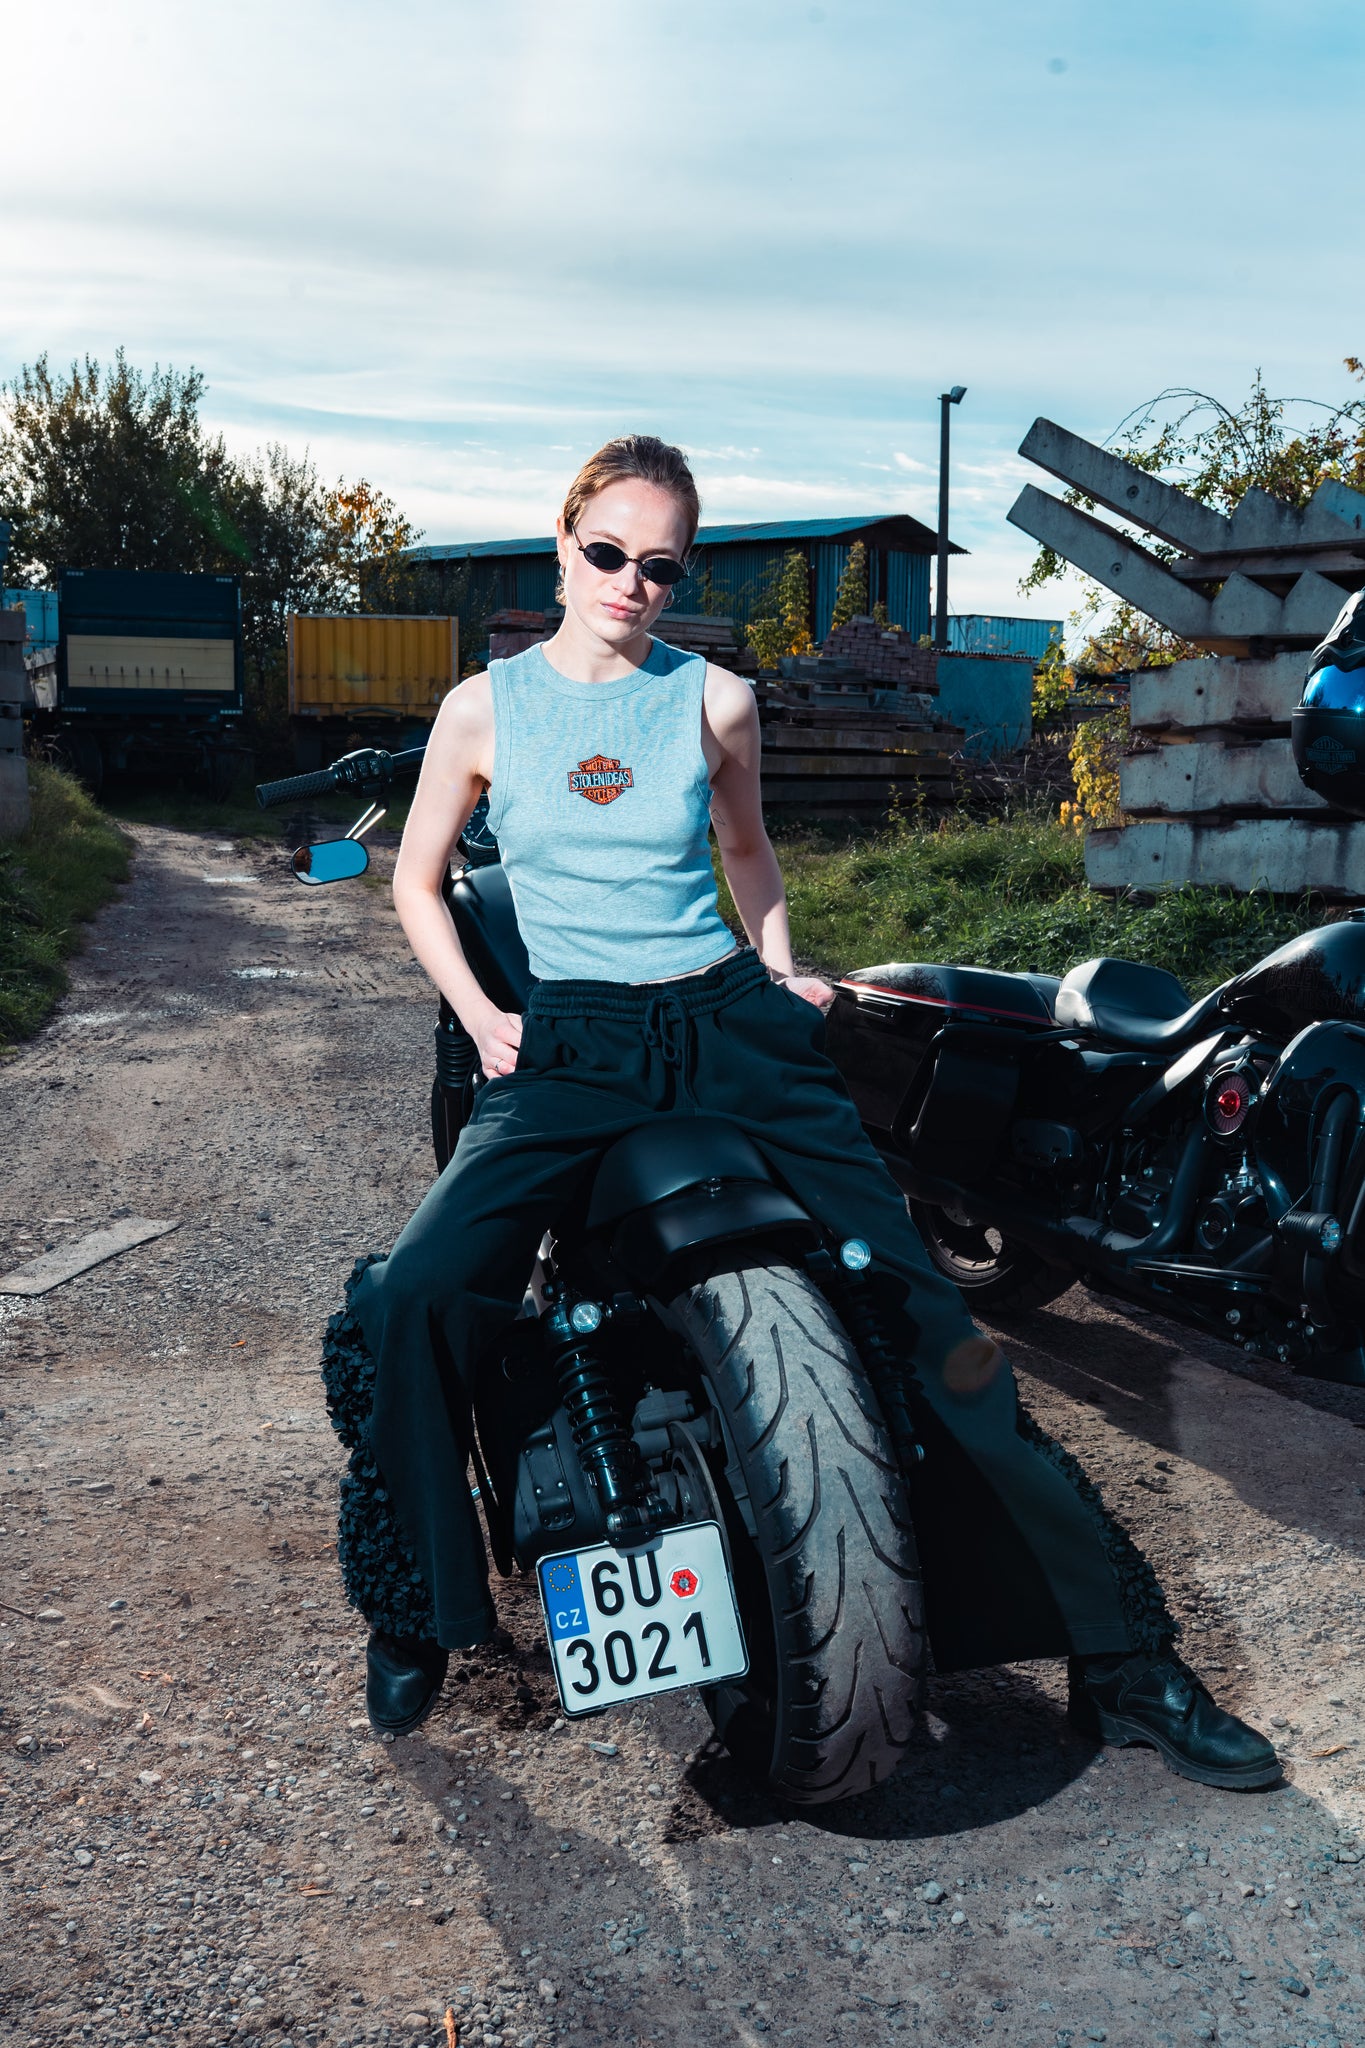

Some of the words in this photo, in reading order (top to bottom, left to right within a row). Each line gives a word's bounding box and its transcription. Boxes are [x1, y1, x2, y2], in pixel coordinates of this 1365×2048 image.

[591, 1551, 662, 1616] 6U
[555, 1608, 583, 1630] CZ
[566, 1611, 711, 1695] 3021
